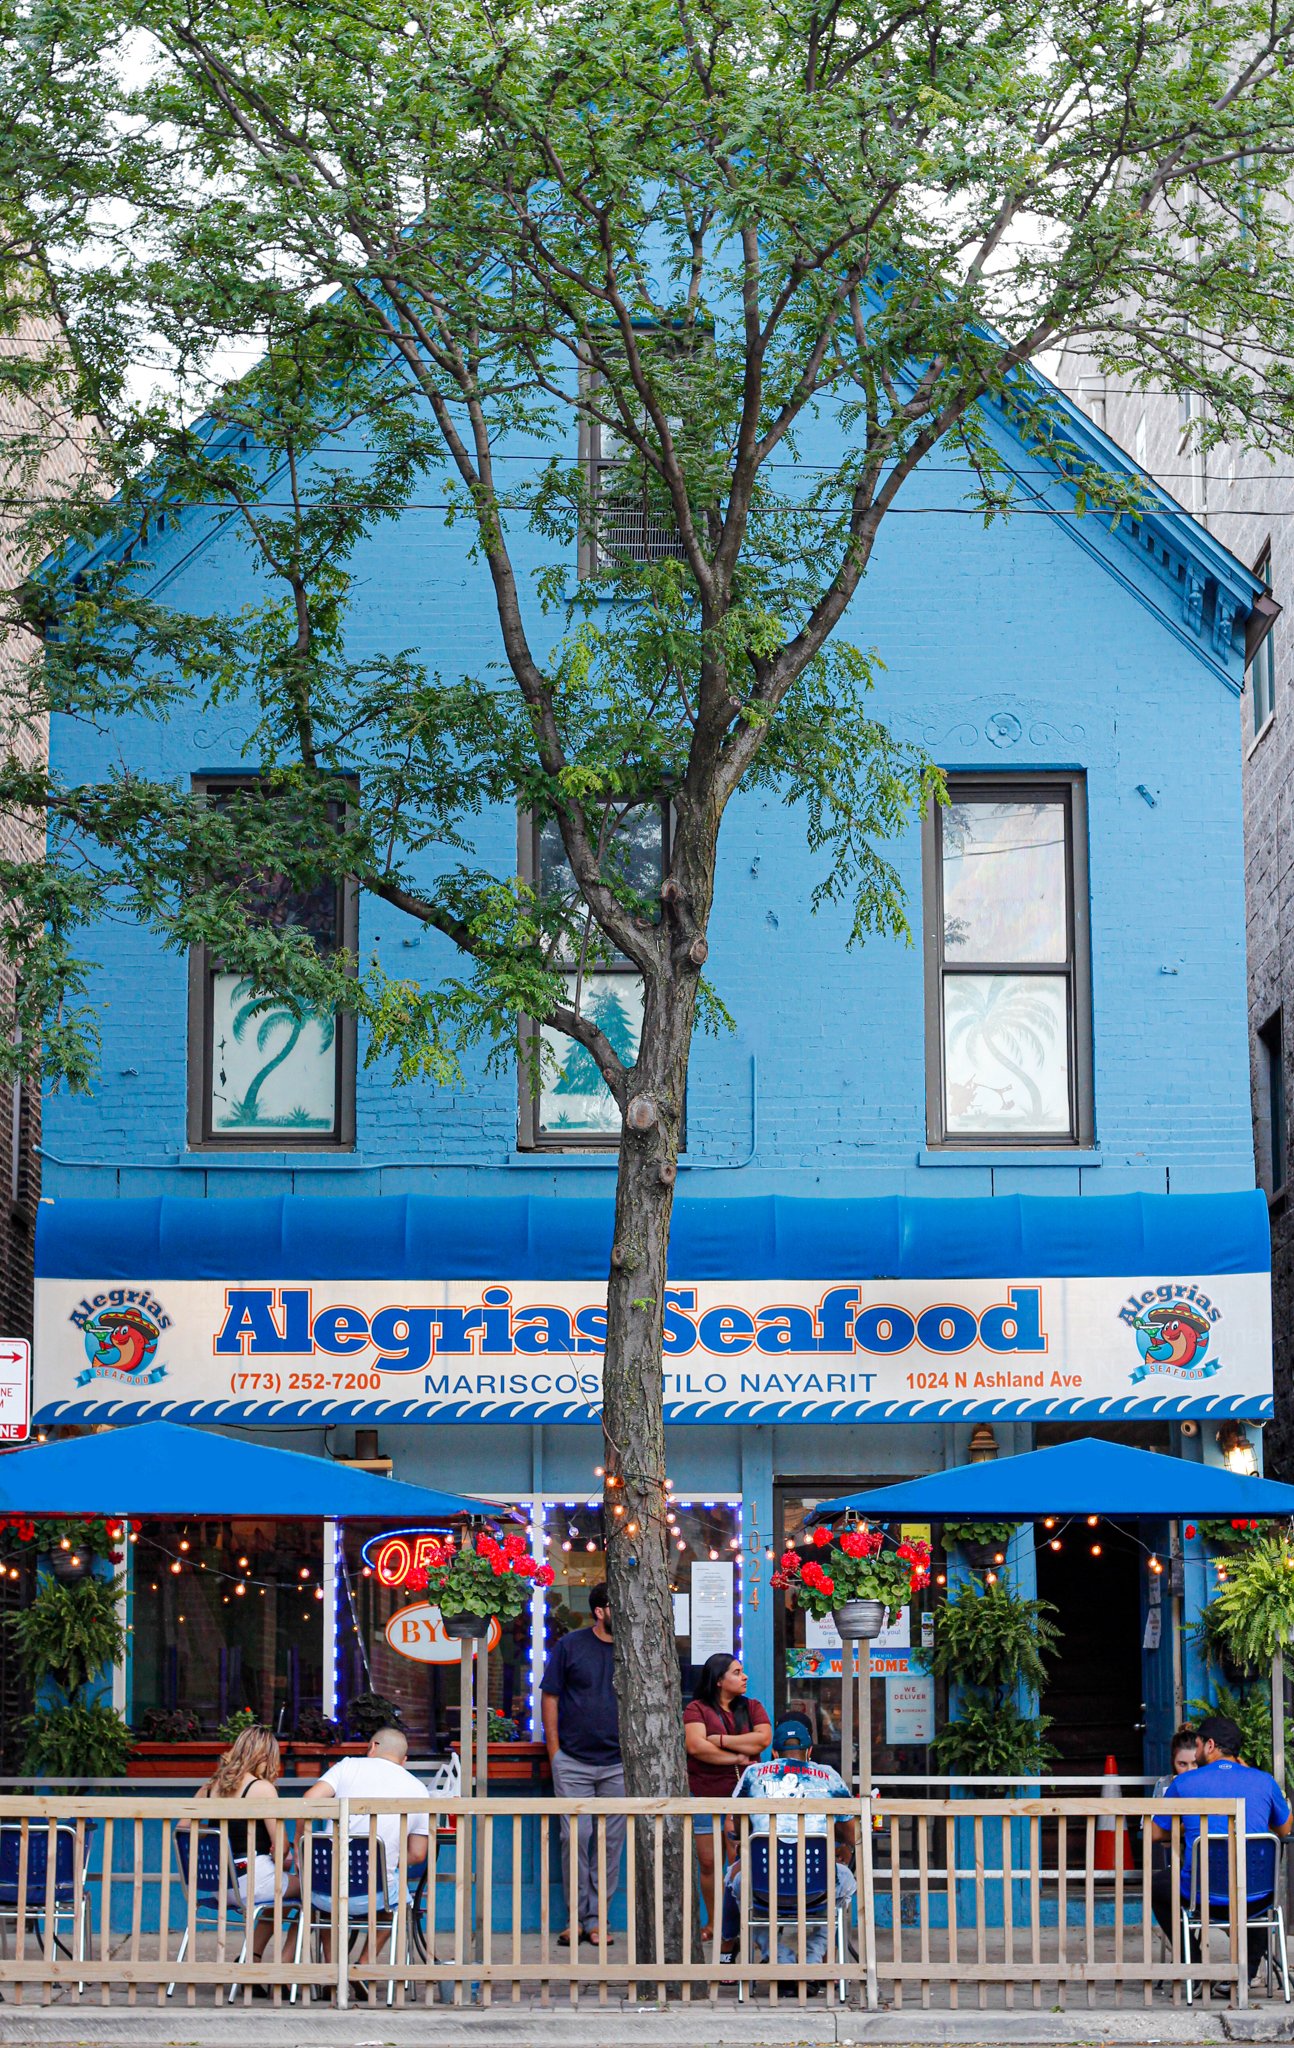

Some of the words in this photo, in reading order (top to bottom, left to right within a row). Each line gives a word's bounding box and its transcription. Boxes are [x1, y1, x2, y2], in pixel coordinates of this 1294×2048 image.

[69, 1289, 172, 1329] Alegrias
[1118, 1284, 1222, 1326] Alegrias
[213, 1286, 608, 1375] Alegrias
[662, 1285, 1048, 1357] Seafood
[96, 1369, 149, 1384] SEAFOOD
[906, 1372, 949, 1389] 1024
[955, 1371, 967, 1388] N
[973, 1370, 1044, 1388] Ashland
[1050, 1370, 1082, 1388] Ave
[1150, 1365, 1203, 1379] SEAFOOD
[0, 1388, 13, 1397] NE
[230, 1373, 281, 1394] (773)
[288, 1373, 381, 1390] 252-7200
[425, 1374, 599, 1394] MARISCOS
[661, 1373, 727, 1393] TILO
[741, 1373, 878, 1393] NAYARIT
[0, 1424, 19, 1438] NE
[377, 1537, 441, 1586] OP
[757, 1764, 780, 1777] TRUE
[783, 1765, 830, 1780] RELIGION
